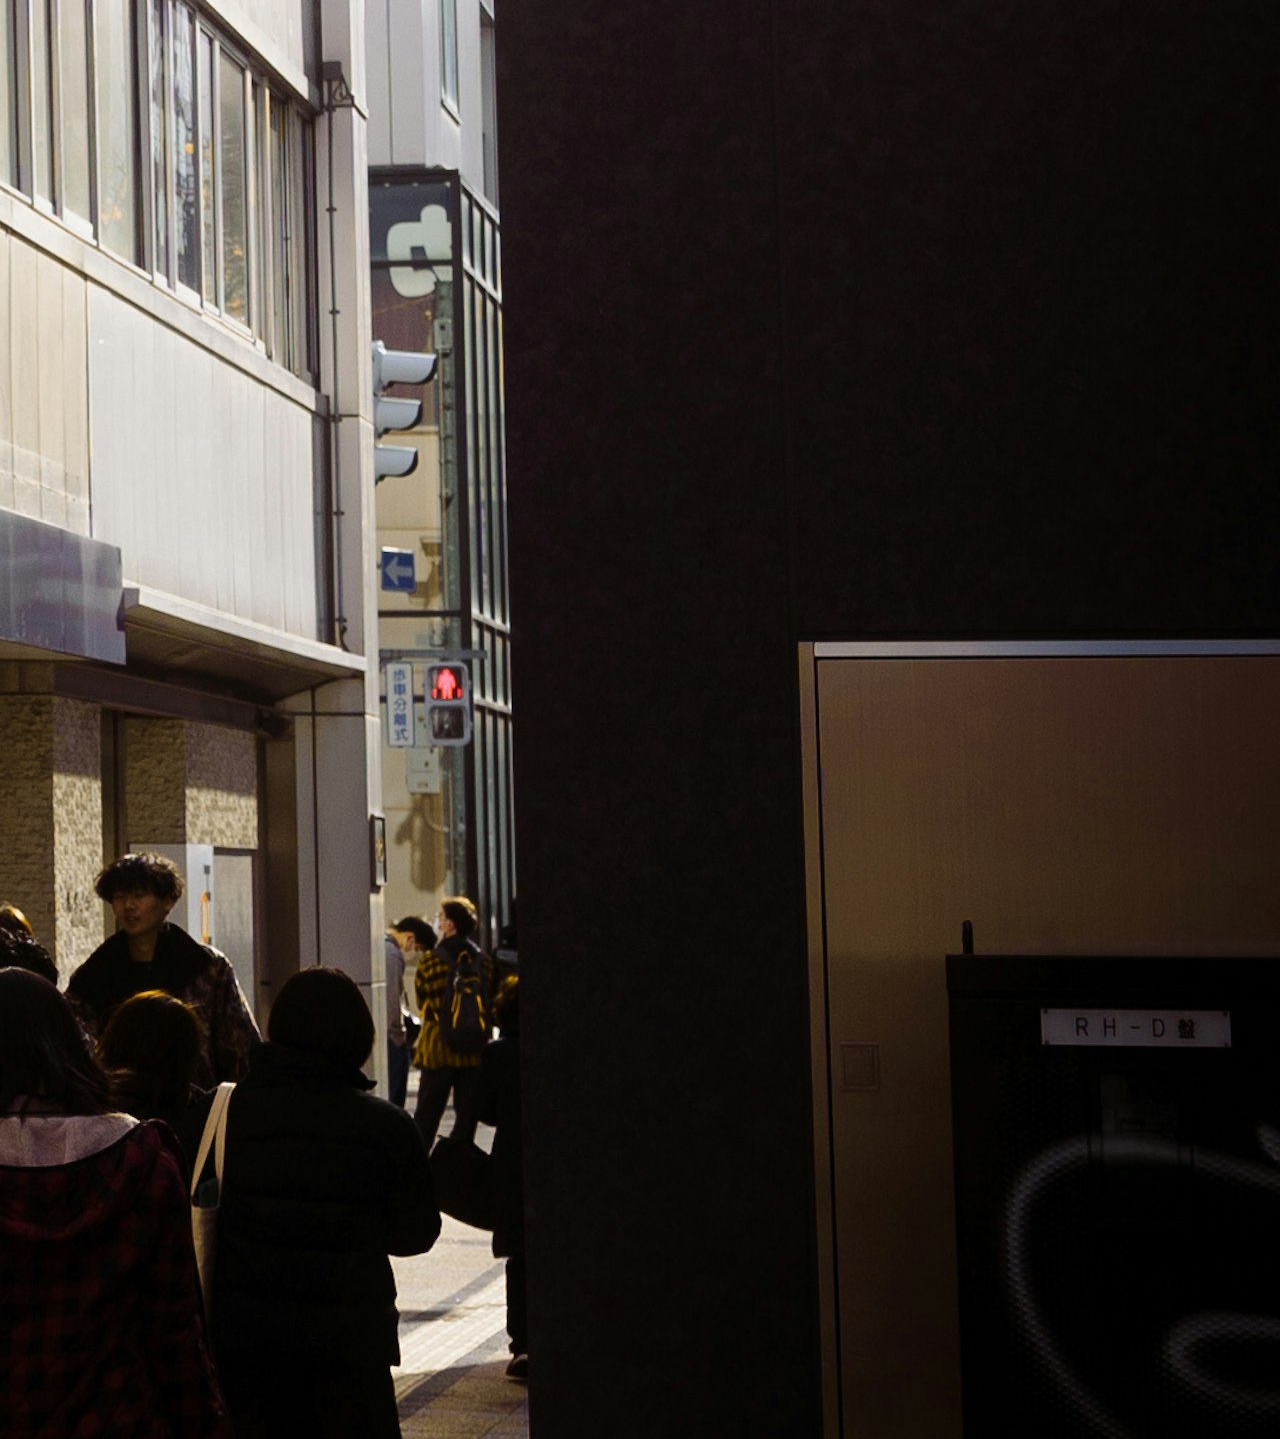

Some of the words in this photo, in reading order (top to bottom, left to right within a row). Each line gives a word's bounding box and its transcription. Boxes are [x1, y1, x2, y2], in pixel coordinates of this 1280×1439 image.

[392, 666, 410, 742] 歩車分離式
